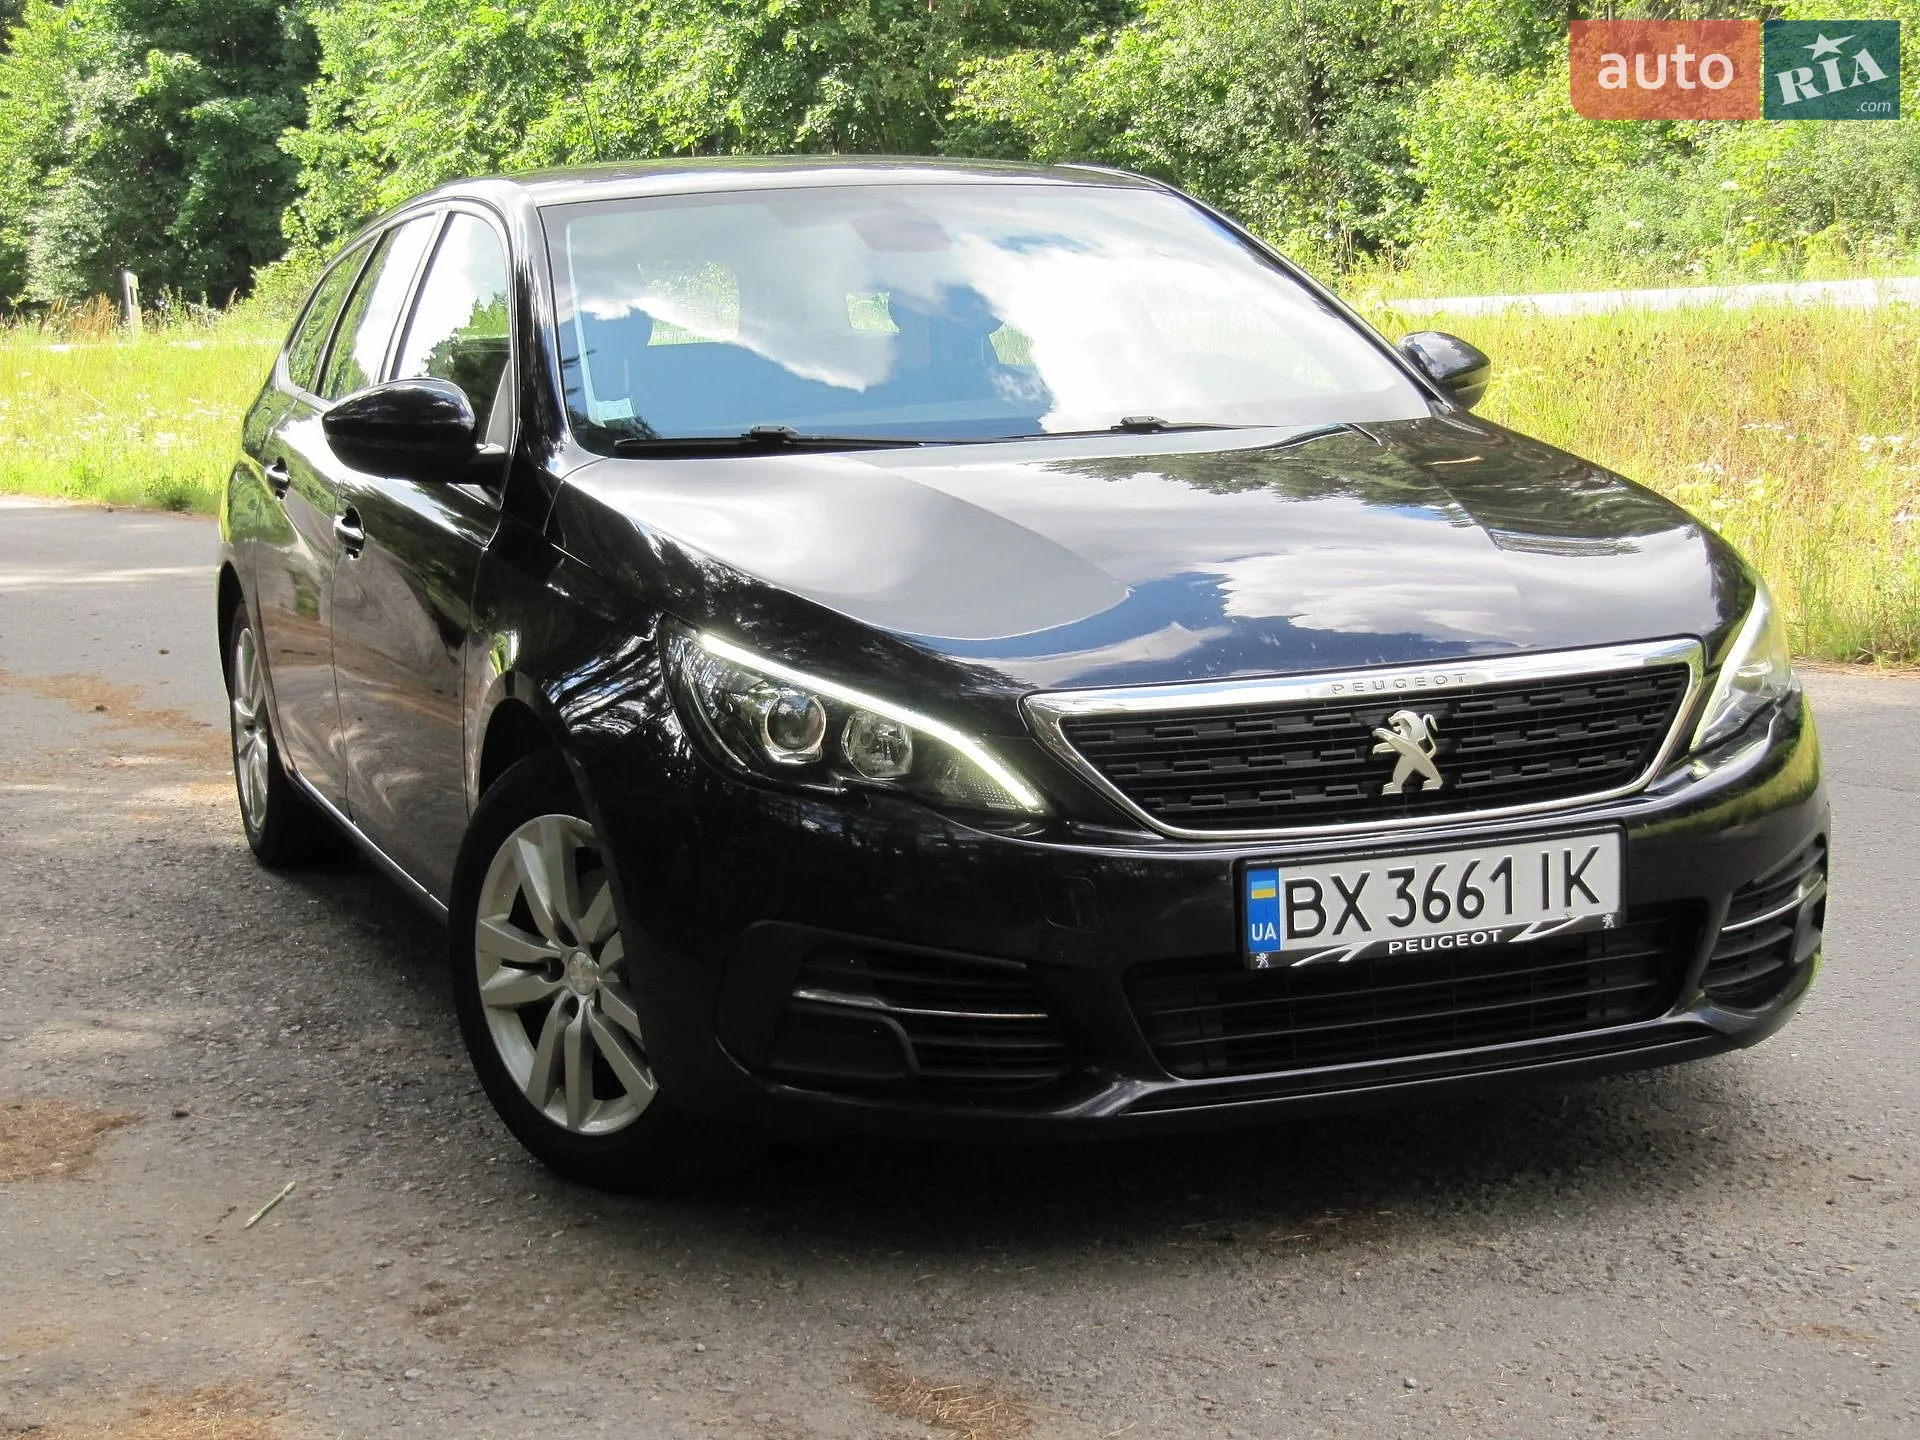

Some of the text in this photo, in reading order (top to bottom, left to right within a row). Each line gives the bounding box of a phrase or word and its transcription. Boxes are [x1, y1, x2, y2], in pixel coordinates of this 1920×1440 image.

[1331, 673, 1467, 695] PEUGEOT
[1284, 845, 1600, 940] BX 3661 IK
[1251, 922, 1277, 942] UA
[1387, 929, 1503, 955] PEUGEOT
